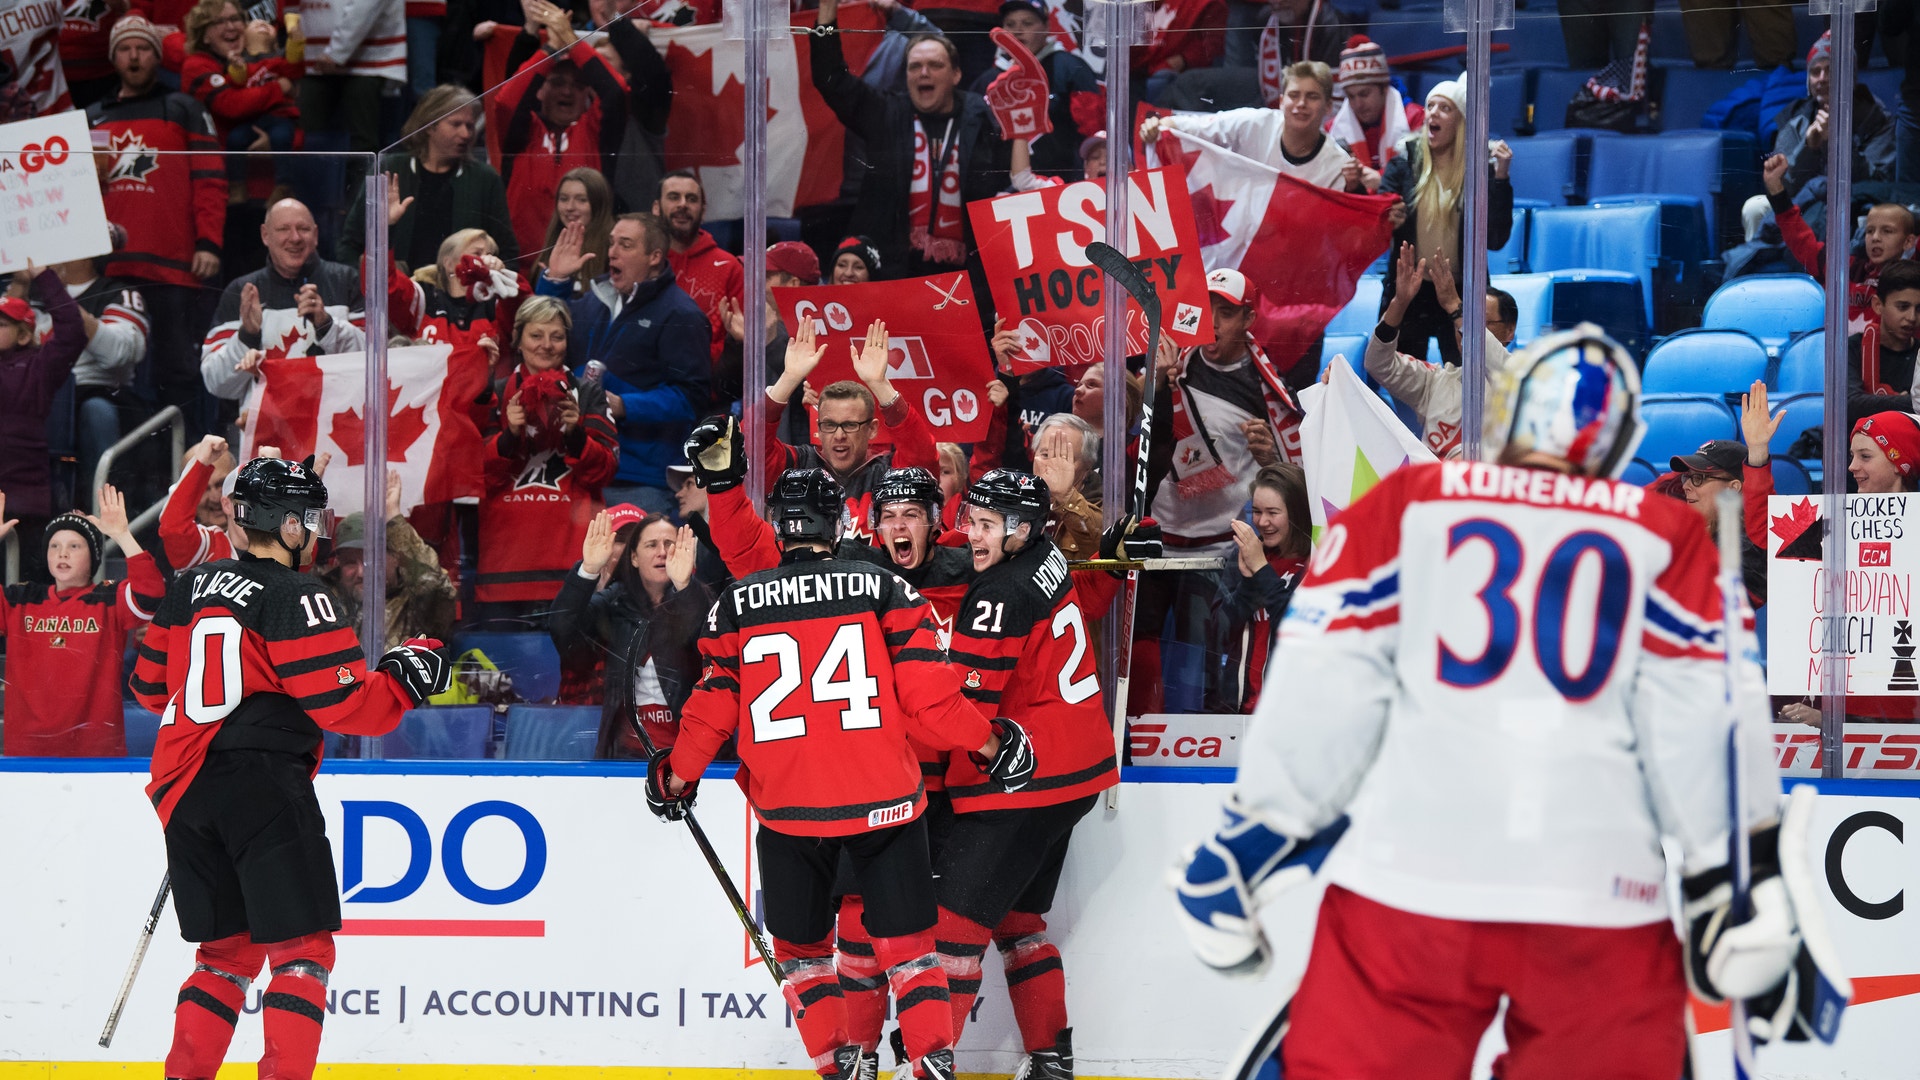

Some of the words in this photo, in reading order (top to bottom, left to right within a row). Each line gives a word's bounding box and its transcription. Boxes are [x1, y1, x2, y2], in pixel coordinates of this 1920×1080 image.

[19, 135, 70, 173] GO
[991, 170, 1178, 270] TSN
[1013, 253, 1183, 316] HOCEY
[794, 299, 853, 336] GO
[923, 387, 979, 427] GO
[1134, 402, 1153, 493] CCM
[503, 493, 571, 503] CANADA
[887, 488, 916, 496] TELUS
[969, 491, 991, 504] TELUS
[1441, 462, 1645, 518] KORENAR
[1843, 496, 1907, 518] HOCKEY
[788, 520, 803, 533] 24
[1851, 518, 1903, 540] CHESS
[1032, 540, 1068, 600] HOWD
[1861, 549, 1888, 564] CCM
[300, 592, 337, 628] 10
[733, 573, 881, 616] FORMENTON
[1436, 517, 1633, 704] 30
[24, 615, 99, 633] CANADA
[972, 600, 1004, 633] 21
[1119, 588, 1134, 676] ETSPEED
[742, 622, 882, 744] 24
[1130, 723, 1222, 758] S.ca
[1843, 733, 1920, 770] TS
[881, 803, 909, 823] IIHF
[340, 800, 548, 905] DO
[422, 990, 660, 1018] ACCOUNTING
[701, 992, 768, 1019] TAX
